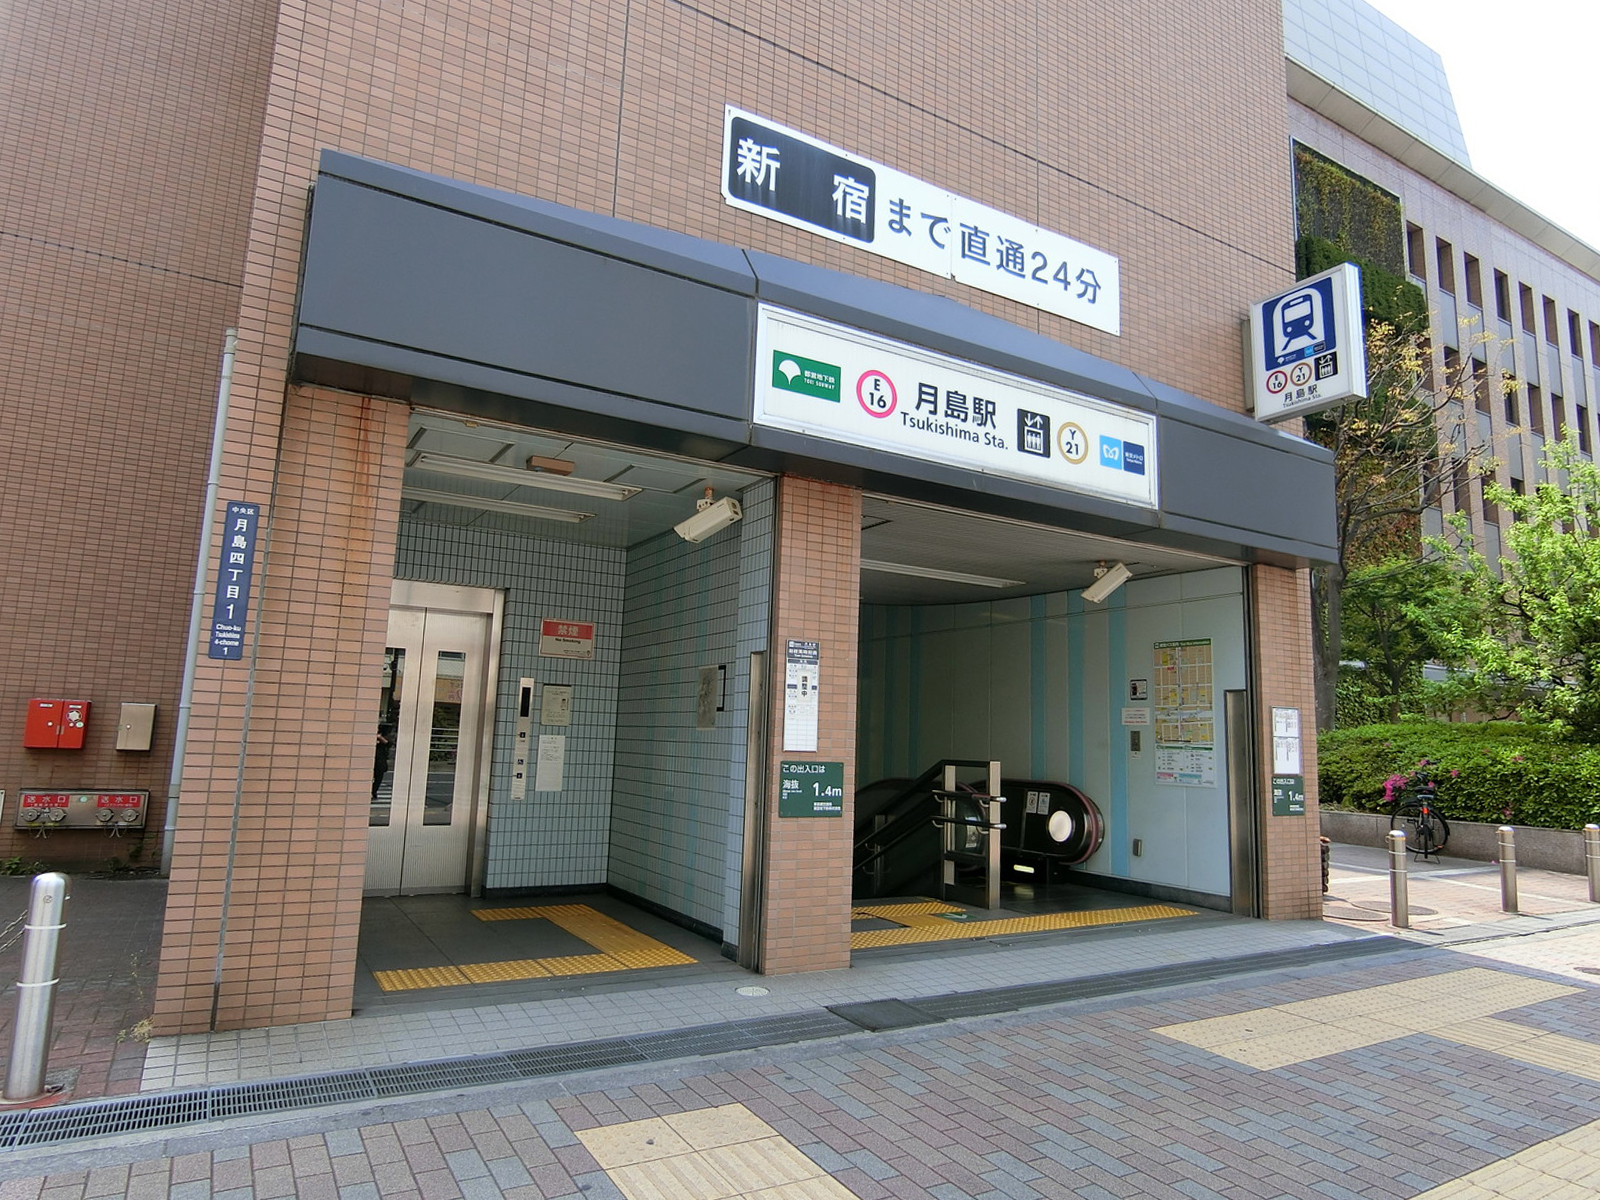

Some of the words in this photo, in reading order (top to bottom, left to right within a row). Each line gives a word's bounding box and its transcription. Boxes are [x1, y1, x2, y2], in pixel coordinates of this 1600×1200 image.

[1296, 373, 1306, 383] 21
[873, 378, 882, 393] E
[1273, 381, 1283, 389] 16
[1284, 384, 1318, 403] 月島駅
[868, 393, 887, 409] 16
[915, 382, 997, 430] 月島駅
[900, 411, 980, 444] Tsukishima
[984, 432, 1008, 451] Sta.
[1068, 428, 1077, 441] Y
[1065, 441, 1081, 456] 21
[231, 506, 254, 515] 中央区
[215, 623, 242, 632] Chuo-ku
[557, 624, 579, 637] 禁煙
[214, 639, 240, 647] 4-chome
[222, 647, 228, 655] 1
[781, 764, 826, 773] この出入口は
[782, 779, 799, 789] 海抜
[813, 782, 842, 797] 1.4m
[27, 795, 66, 804] 送水口
[101, 795, 138, 804] 送水口
